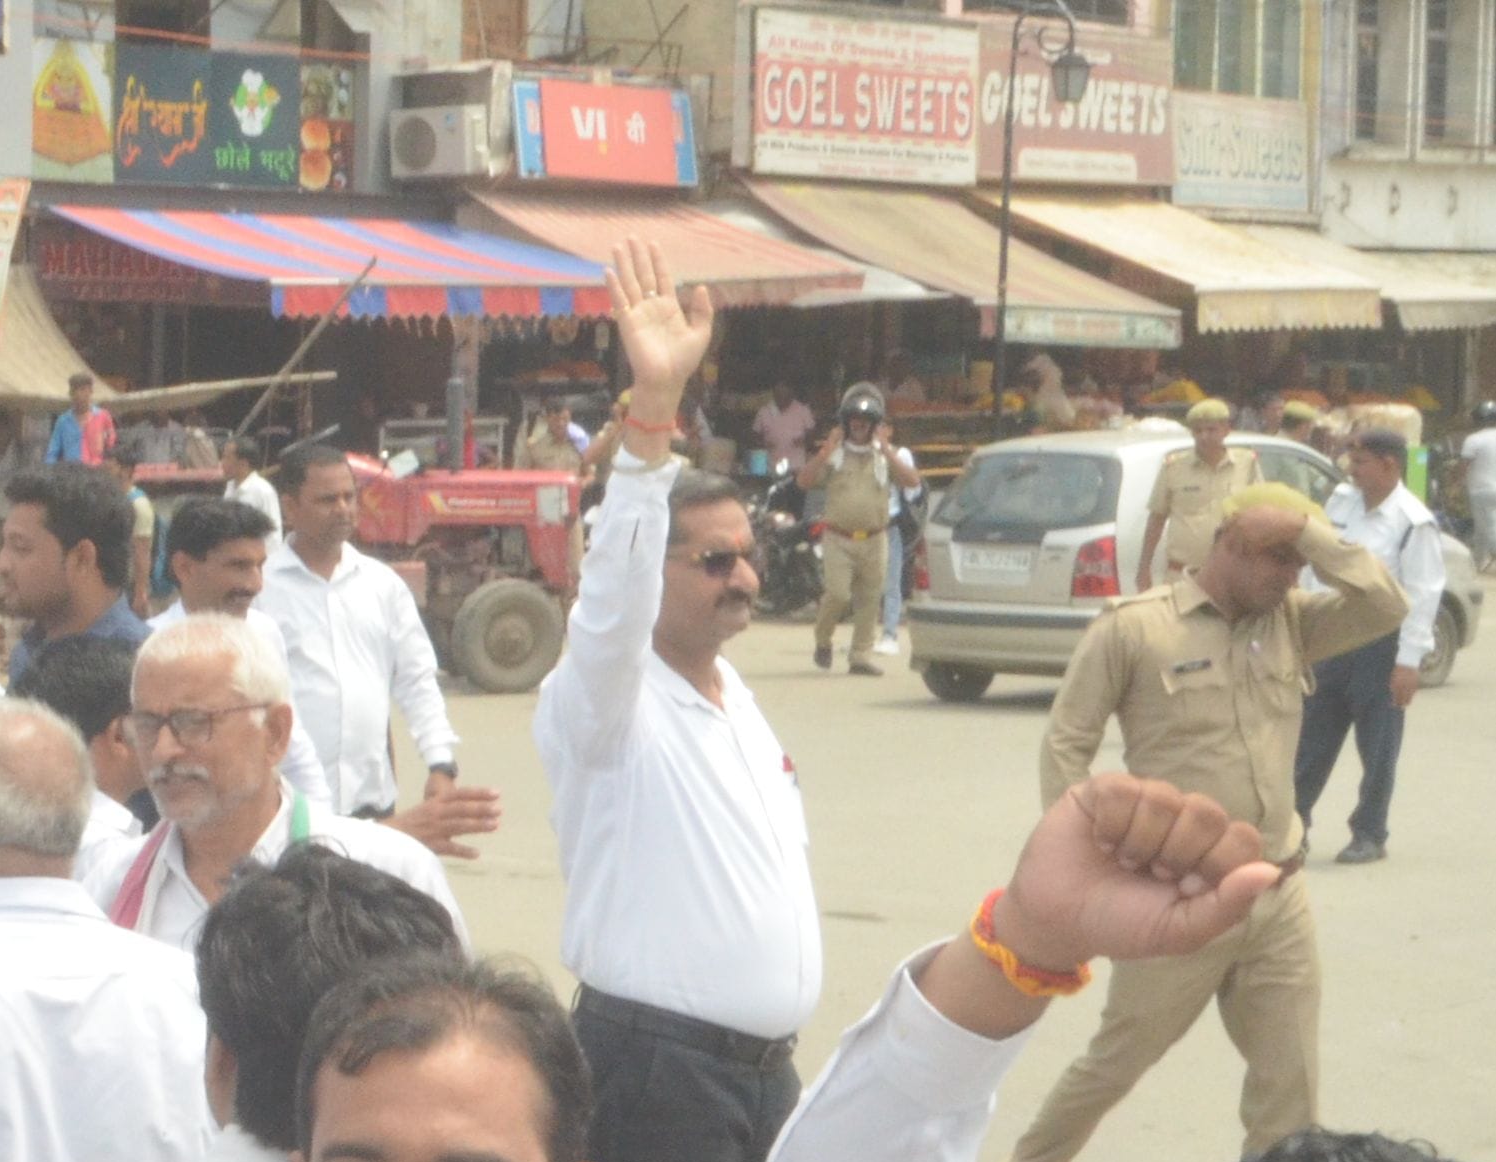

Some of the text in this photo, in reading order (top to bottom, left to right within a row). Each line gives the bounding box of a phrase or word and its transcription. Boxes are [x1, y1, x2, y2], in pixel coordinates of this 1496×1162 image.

[763, 64, 972, 139] GOEL SWEETS
[626, 112, 647, 144] वी
[215, 138, 296, 181] छोले भटूरे
